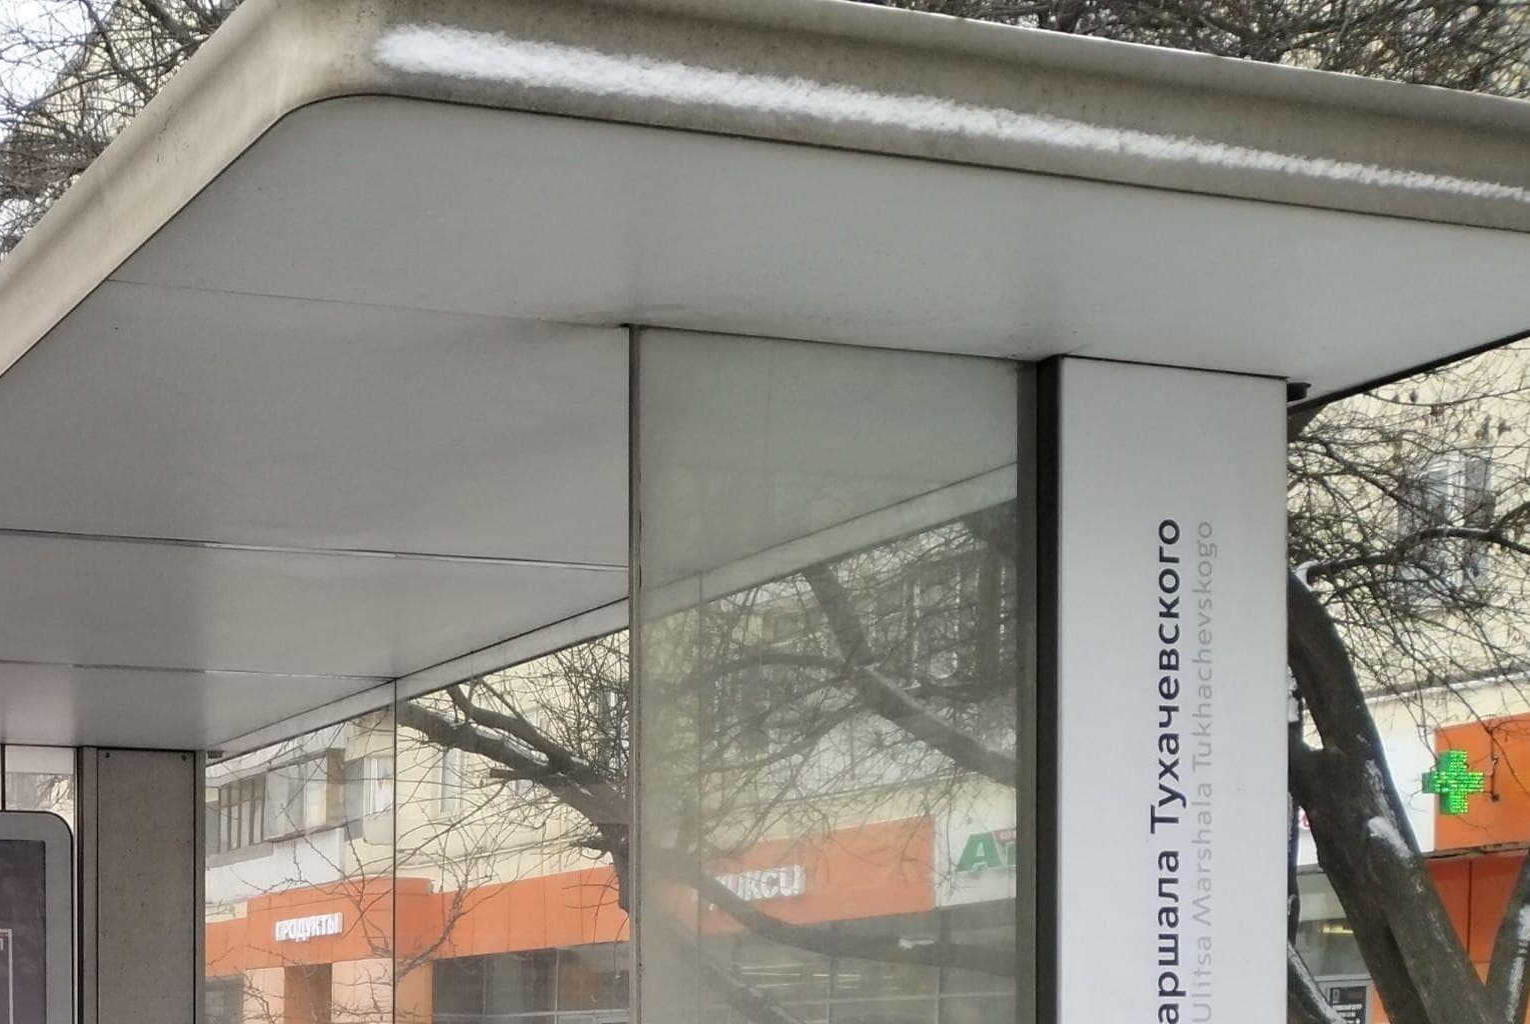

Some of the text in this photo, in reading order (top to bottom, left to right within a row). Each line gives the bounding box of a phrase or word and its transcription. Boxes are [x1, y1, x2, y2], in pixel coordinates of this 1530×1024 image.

[1150, 519, 1187, 834] Тухачевского
[1191, 520, 1218, 1024] Ulitsa Marshala Tukhachevskogo
[275, 912, 343, 942] ПРОДУКТЫ
